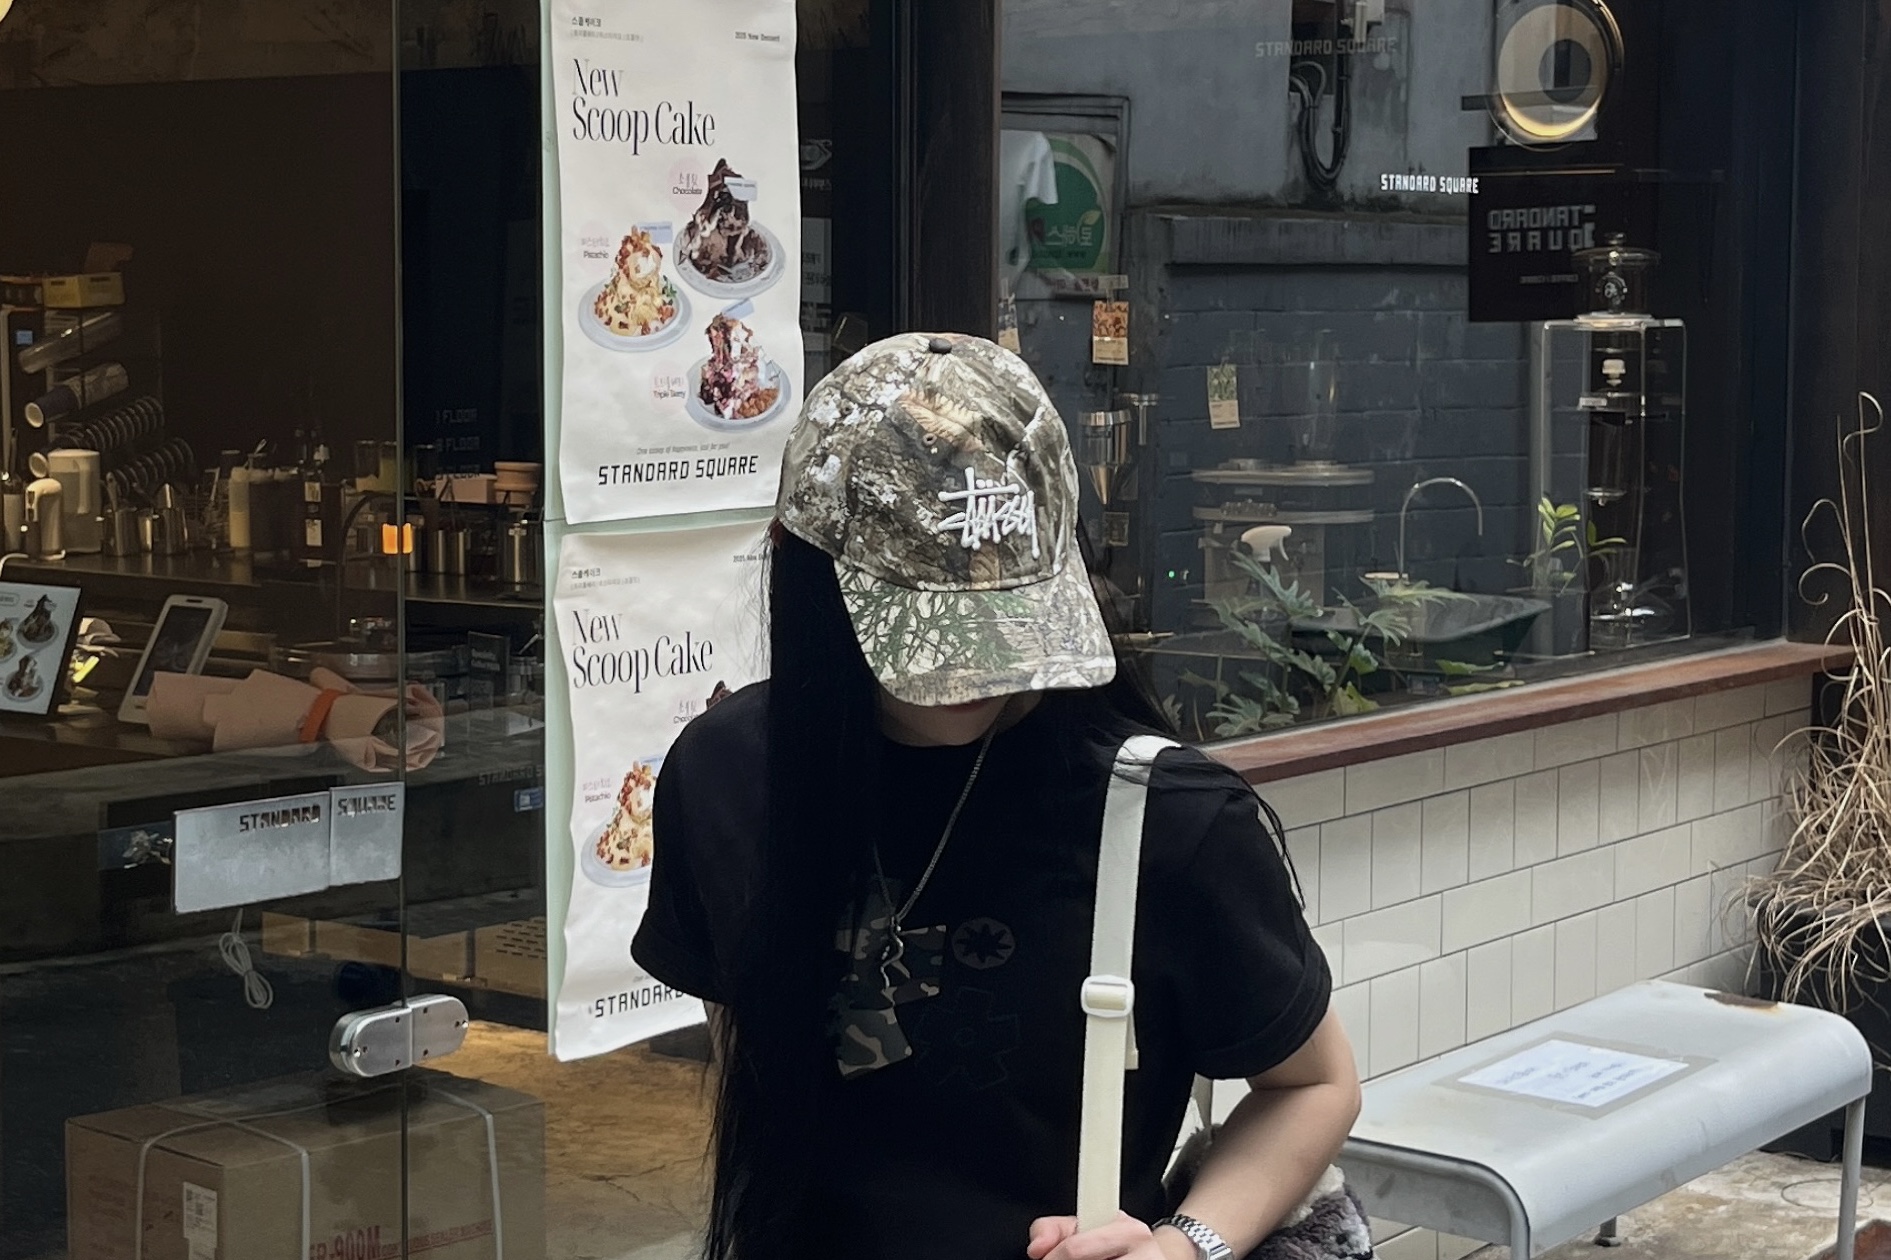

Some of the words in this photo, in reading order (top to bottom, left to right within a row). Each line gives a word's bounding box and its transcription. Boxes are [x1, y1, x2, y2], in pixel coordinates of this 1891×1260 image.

[1255, 39, 1332, 57] STANDARD
[1337, 37, 1397, 54] SQUARE
[572, 58, 624, 97] New
[572, 96, 649, 156] Scoop
[655, 100, 716, 146] Cake
[1380, 173, 1436, 192] STANDARD
[1438, 175, 1480, 195] SQUARE
[598, 459, 690, 486] STANDARD
[696, 455, 759, 480] SQUARE
[572, 608, 623, 646] New
[573, 645, 650, 693] Scoop
[654, 631, 713, 678] Cake
[239, 803, 321, 832] STANDARD
